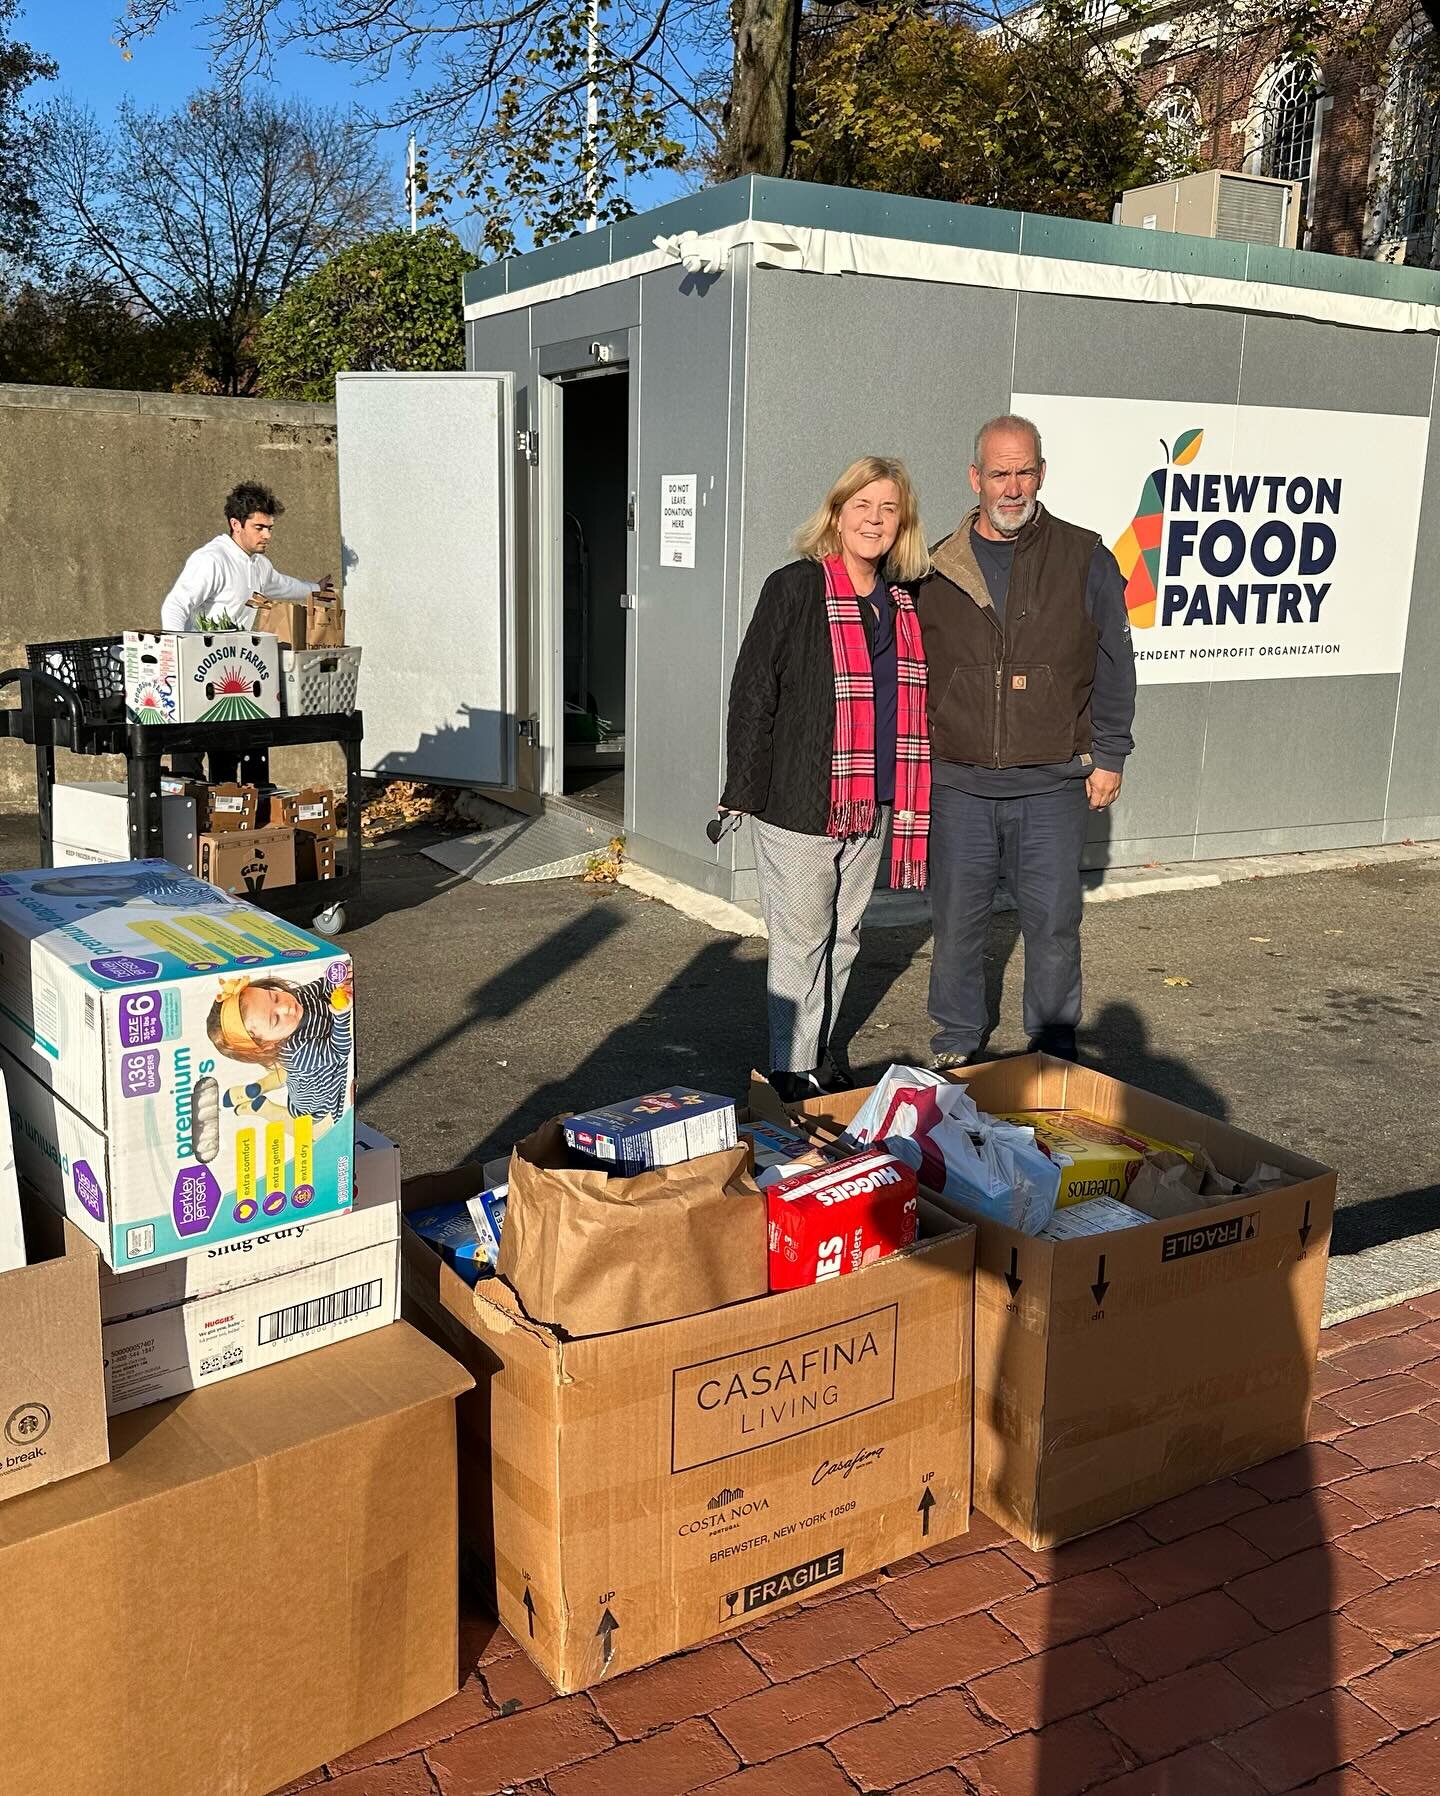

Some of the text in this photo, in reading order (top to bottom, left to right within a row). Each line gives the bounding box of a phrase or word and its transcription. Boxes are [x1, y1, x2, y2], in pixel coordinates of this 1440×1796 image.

[668, 484, 689, 493] DO NOT
[1171, 474, 1342, 514] NEWTON
[671, 496, 686, 504] LEAVE
[664, 508, 693, 517] DONATIONS
[672, 520, 685, 528] HERE
[1165, 519, 1337, 578] FOOD
[1161, 583, 1332, 627] PANTRY
[1190, 647, 1254, 659] NONPROFIT
[1260, 644, 1341, 656] ORGANIZATION
[194, 646, 236, 683] GOODSON
[240, 647, 270, 681] FARMS
[16, 896, 66, 923] diapers
[54, 921, 122, 955] premium
[126, 995, 154, 1044] SIZE 6
[128, 1056, 147, 1092] 136
[147, 1054, 155, 1088] DIAPERS
[171, 1046, 196, 1159] premium
[273, 1138, 281, 1167] gentle
[301, 1144, 310, 1163] dry
[778, 1184, 789, 1192] 3
[816, 1166, 902, 1208] HUGGIES
[1068, 1178, 1121, 1198] Cheerios
[180, 1177, 196, 1224] berkley
[904, 1198, 917, 1214] 3
[256, 1234, 270, 1245] &
[784, 1235, 793, 1245] 3
[1166, 1222, 1239, 1258] FRAGILE
[1296, 1250, 1308, 1262] UP
[1006, 1303, 1019, 1314] UP
[1091, 1310, 1105, 1321] UP
[204, 1315, 235, 1329] HUGGIES
[283, 1336, 294, 1344] 00
[696, 1331, 879, 1410] CASAFINA
[741, 1385, 839, 1434] LIVING
[6, 1448, 46, 1468] break.
[812, 1447, 885, 1486] Casafina
[922, 1471, 934, 1484] UP
[678, 1498, 770, 1537] COSTA NOVA
[708, 1523, 740, 1537] PORTUGAL
[710, 1500, 857, 1563] BREWSTER, NEW YORK 10509
[521, 1568, 532, 1582] UP
[749, 1554, 840, 1606] FRAGILE
[599, 1591, 616, 1605] UP
